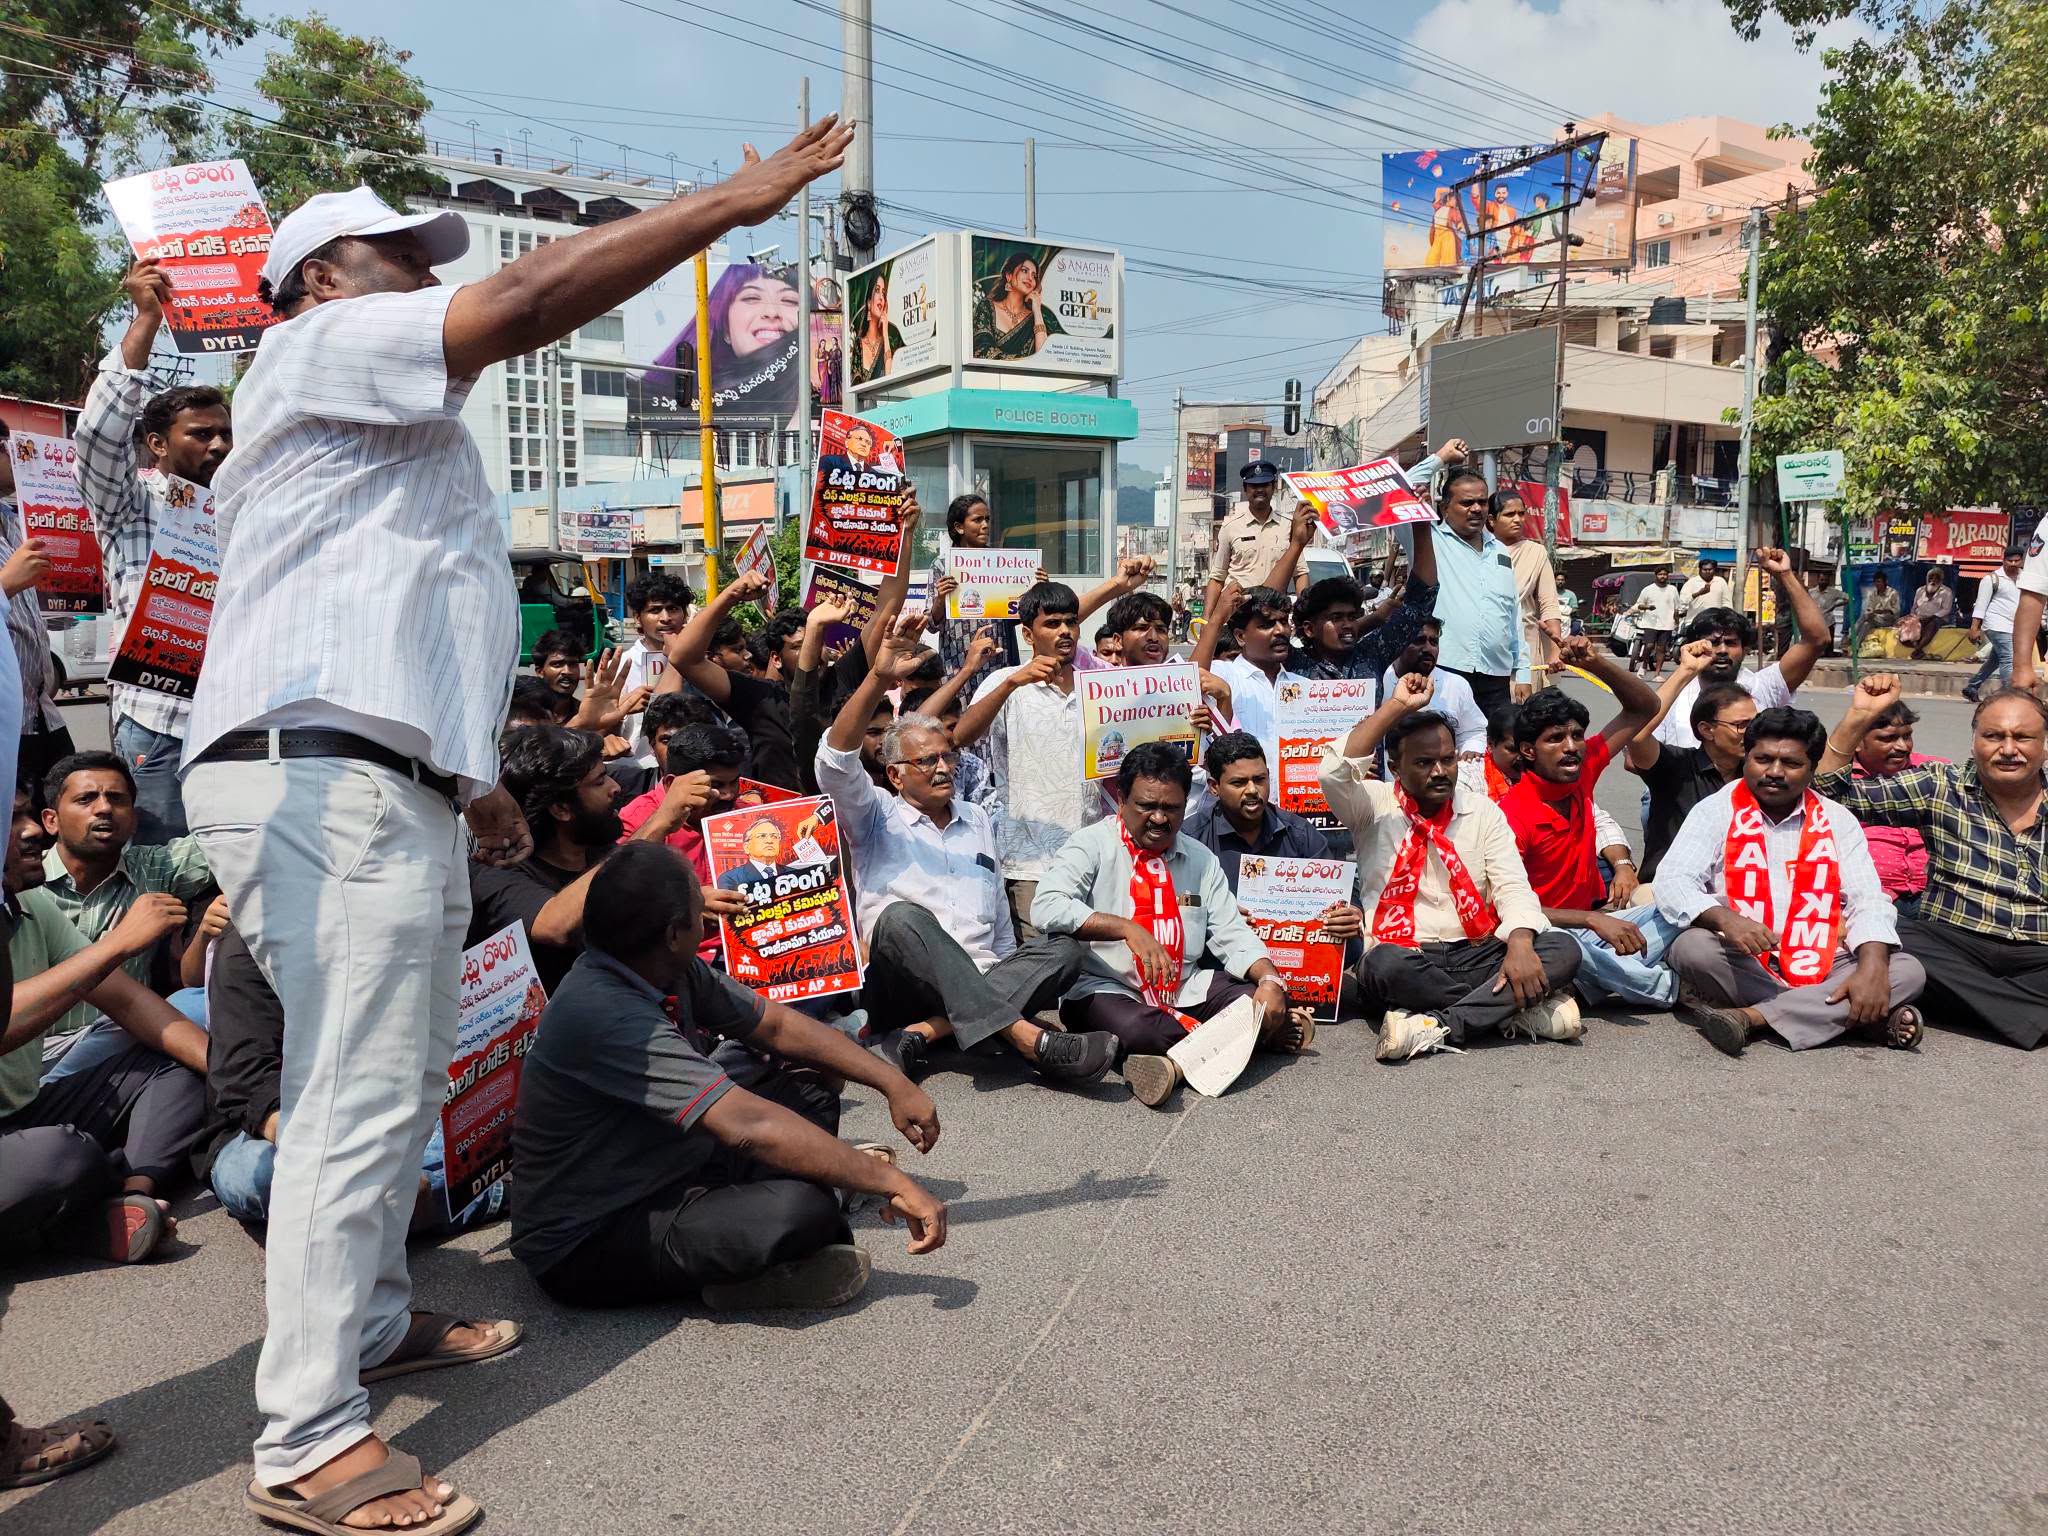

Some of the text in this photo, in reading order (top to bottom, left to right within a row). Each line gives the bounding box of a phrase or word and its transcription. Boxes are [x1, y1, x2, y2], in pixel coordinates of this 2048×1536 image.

[184, 163, 235, 185] దొంగ
[186, 235, 227, 257] లోక్
[229, 233, 273, 257] భవన్
[189, 268, 199, 276] 10
[1068, 260, 1111, 274] ANAGHA
[172, 295, 200, 308] లెనిన్
[201, 293, 236, 306] సెంటర్
[903, 282, 927, 310] BUY 2
[1060, 288, 1098, 306] BUY 2
[902, 307, 920, 328] GET
[1058, 303, 1089, 319] GET
[1097, 307, 1113, 315] FREE
[202, 335, 246, 351] DYFI
[651, 396, 659, 407] 3
[890, 414, 913, 430] BOOTH
[995, 409, 1097, 426] POLICE BOOTH
[44, 443, 64, 468] ఓట్ల
[828, 468, 897, 492] ఓట్ల దొంగ
[1293, 463, 1397, 489] GYANESH KUMAR
[823, 489, 904, 507] చీఫ్ ఎలక్షన్ కమిషనర్
[1311, 478, 1401, 501] MUST RESIGN
[27, 511, 79, 531] ఛలో లోక్
[856, 506, 888, 519] కుమార్
[832, 519, 870, 531] రాజీనామా
[1583, 517, 1605, 530] Flair
[1888, 527, 1916, 536] COFFEE
[814, 527, 829, 540] DYFI
[829, 551, 873, 568] DYFI AP
[954, 555, 1035, 569] Don't Delete
[148, 566, 195, 593] ఛలో
[960, 571, 1033, 588] Democracy
[47, 598, 88, 611] DYFI AP
[179, 604, 189, 613] 10
[178, 618, 188, 627] 10
[141, 625, 206, 652] లెనిన్ సెంటర్
[137, 671, 182, 693] DYFI
[1088, 674, 1193, 701] Don't Delete
[1308, 682, 1367, 704] ఓట్ల దొంగ
[1098, 702, 1194, 725] Democracy
[1280, 742, 1312, 760] ఛలో
[1287, 785, 1306, 795] లెనిన్
[819, 804, 833, 817] ECI
[1307, 816, 1327, 827] YFI
[797, 840, 812, 852] VOTE
[802, 844, 818, 859] SCAM
[1275, 860, 1344, 883] ఓట్ల దొంగ
[775, 865, 826, 897] దొంగ
[755, 900, 792, 922] ఎలక్షన్
[792, 887, 840, 911] కమిషనర్
[784, 908, 825, 932] కుమార్
[1273, 924, 1306, 943] లోక్
[482, 928, 518, 973] దొంగ
[758, 935, 807, 958] రాజీనామా
[737, 962, 760, 976] DYFI
[1310, 973, 1331, 986] ర్యాలీ
[768, 978, 826, 1000] DYFI AP
[478, 1039, 511, 1078] లోక్
[455, 1130, 478, 1156] లెనిన్
[478, 1108, 508, 1137] సెంటర్
[471, 1159, 504, 1196] DYFI
